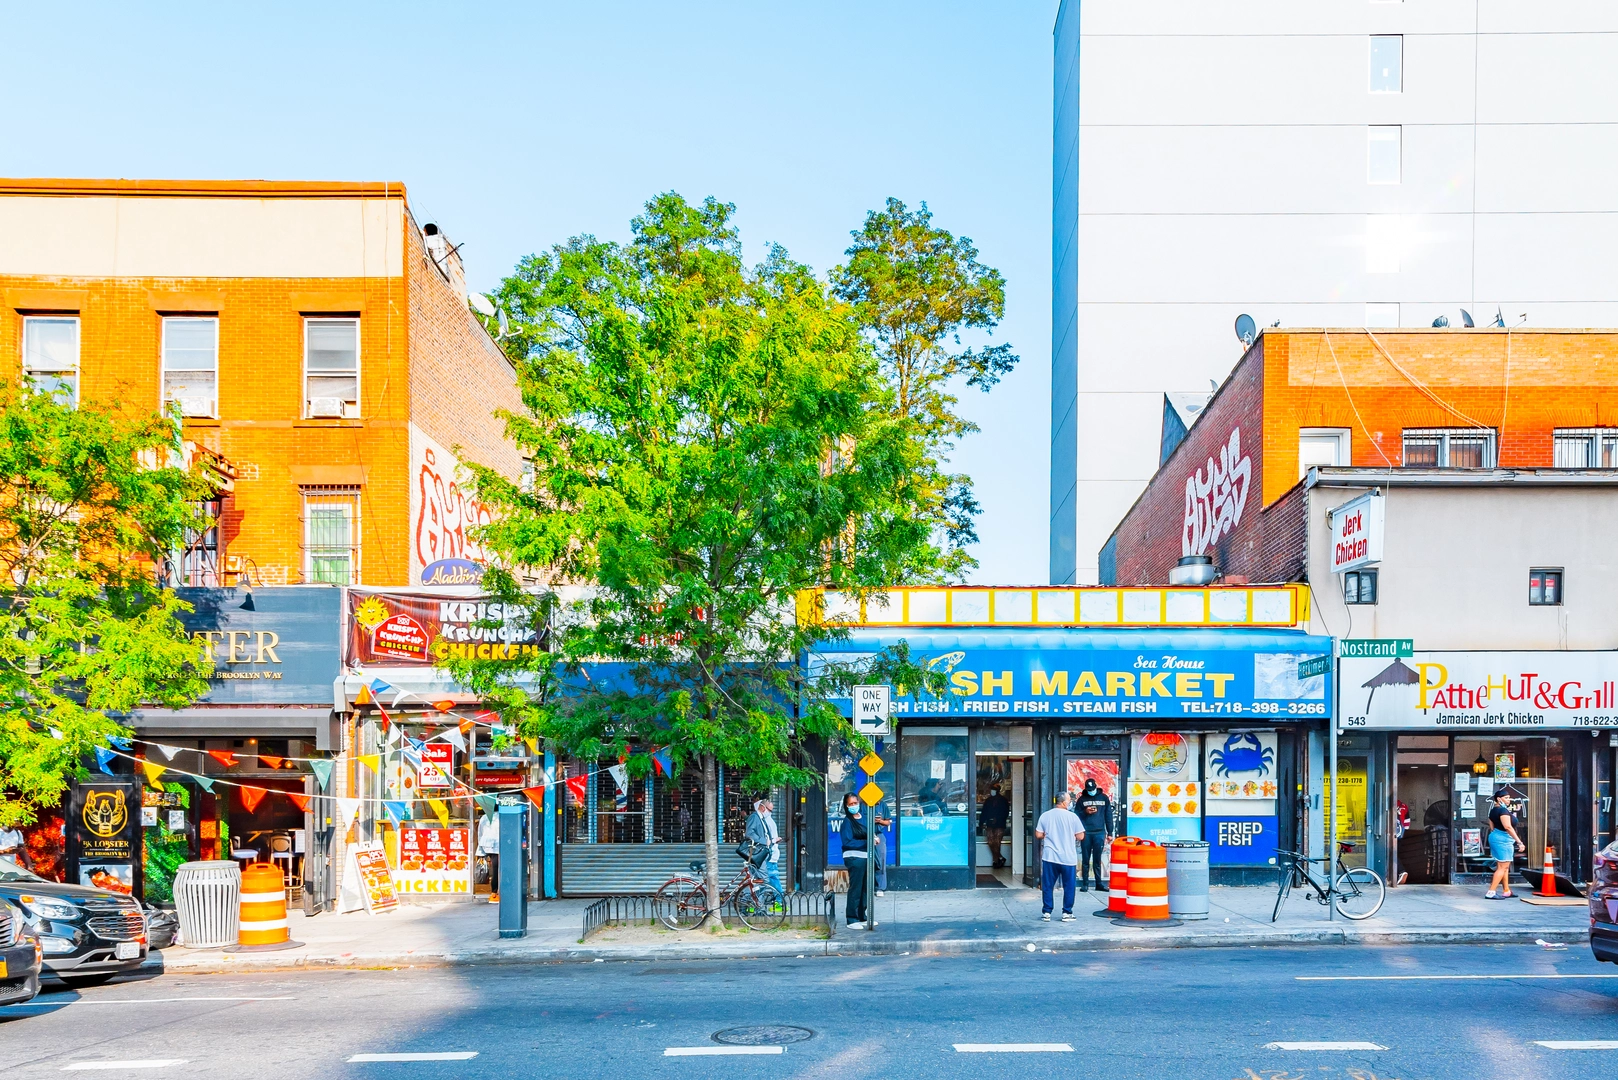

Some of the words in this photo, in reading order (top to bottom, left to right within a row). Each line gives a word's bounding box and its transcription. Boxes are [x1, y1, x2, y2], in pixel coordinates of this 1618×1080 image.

[1342, 509, 1362, 538] Jerk
[1335, 537, 1367, 566] Chicken
[386, 623, 418, 634] KRISPY
[442, 623, 536, 642] KRUNCHY
[380, 641, 420, 652] CHICKEN
[435, 642, 538, 660] CHICKEN
[1341, 640, 1397, 656] Nostrand
[1401, 641, 1411, 650] Av
[1133, 655, 1158, 669] Sea
[1161, 655, 1205, 669] House
[216, 671, 260, 680] BROOKLYN
[263, 671, 282, 680] WAY
[1030, 670, 1235, 698] MARKET
[862, 690, 881, 700] ONE
[862, 702, 882, 712] WAY
[913, 701, 950, 713] FISH
[963, 701, 1010, 713] FRIED
[1014, 701, 1049, 713] FISH
[1063, 701, 1119, 713] STEAM
[1121, 701, 1157, 713] FISH
[1348, 716, 1366, 726] 543
[1436, 712, 1480, 725] Jamaican
[1483, 712, 1506, 725] Jerk
[1508, 712, 1544, 725] Chicken
[1146, 733, 1180, 745] OPEN
[424, 748, 448, 758] Sale
[1464, 794, 1473, 804] A
[1150, 828, 1178, 836] STEAMED
[1218, 821, 1263, 834] FRIED
[404, 830, 417, 842] $5
[427, 830, 440, 842] $5
[449, 830, 462, 842] $5
[1218, 833, 1252, 846] FISH
[94, 840, 129, 849] LOBSTER
